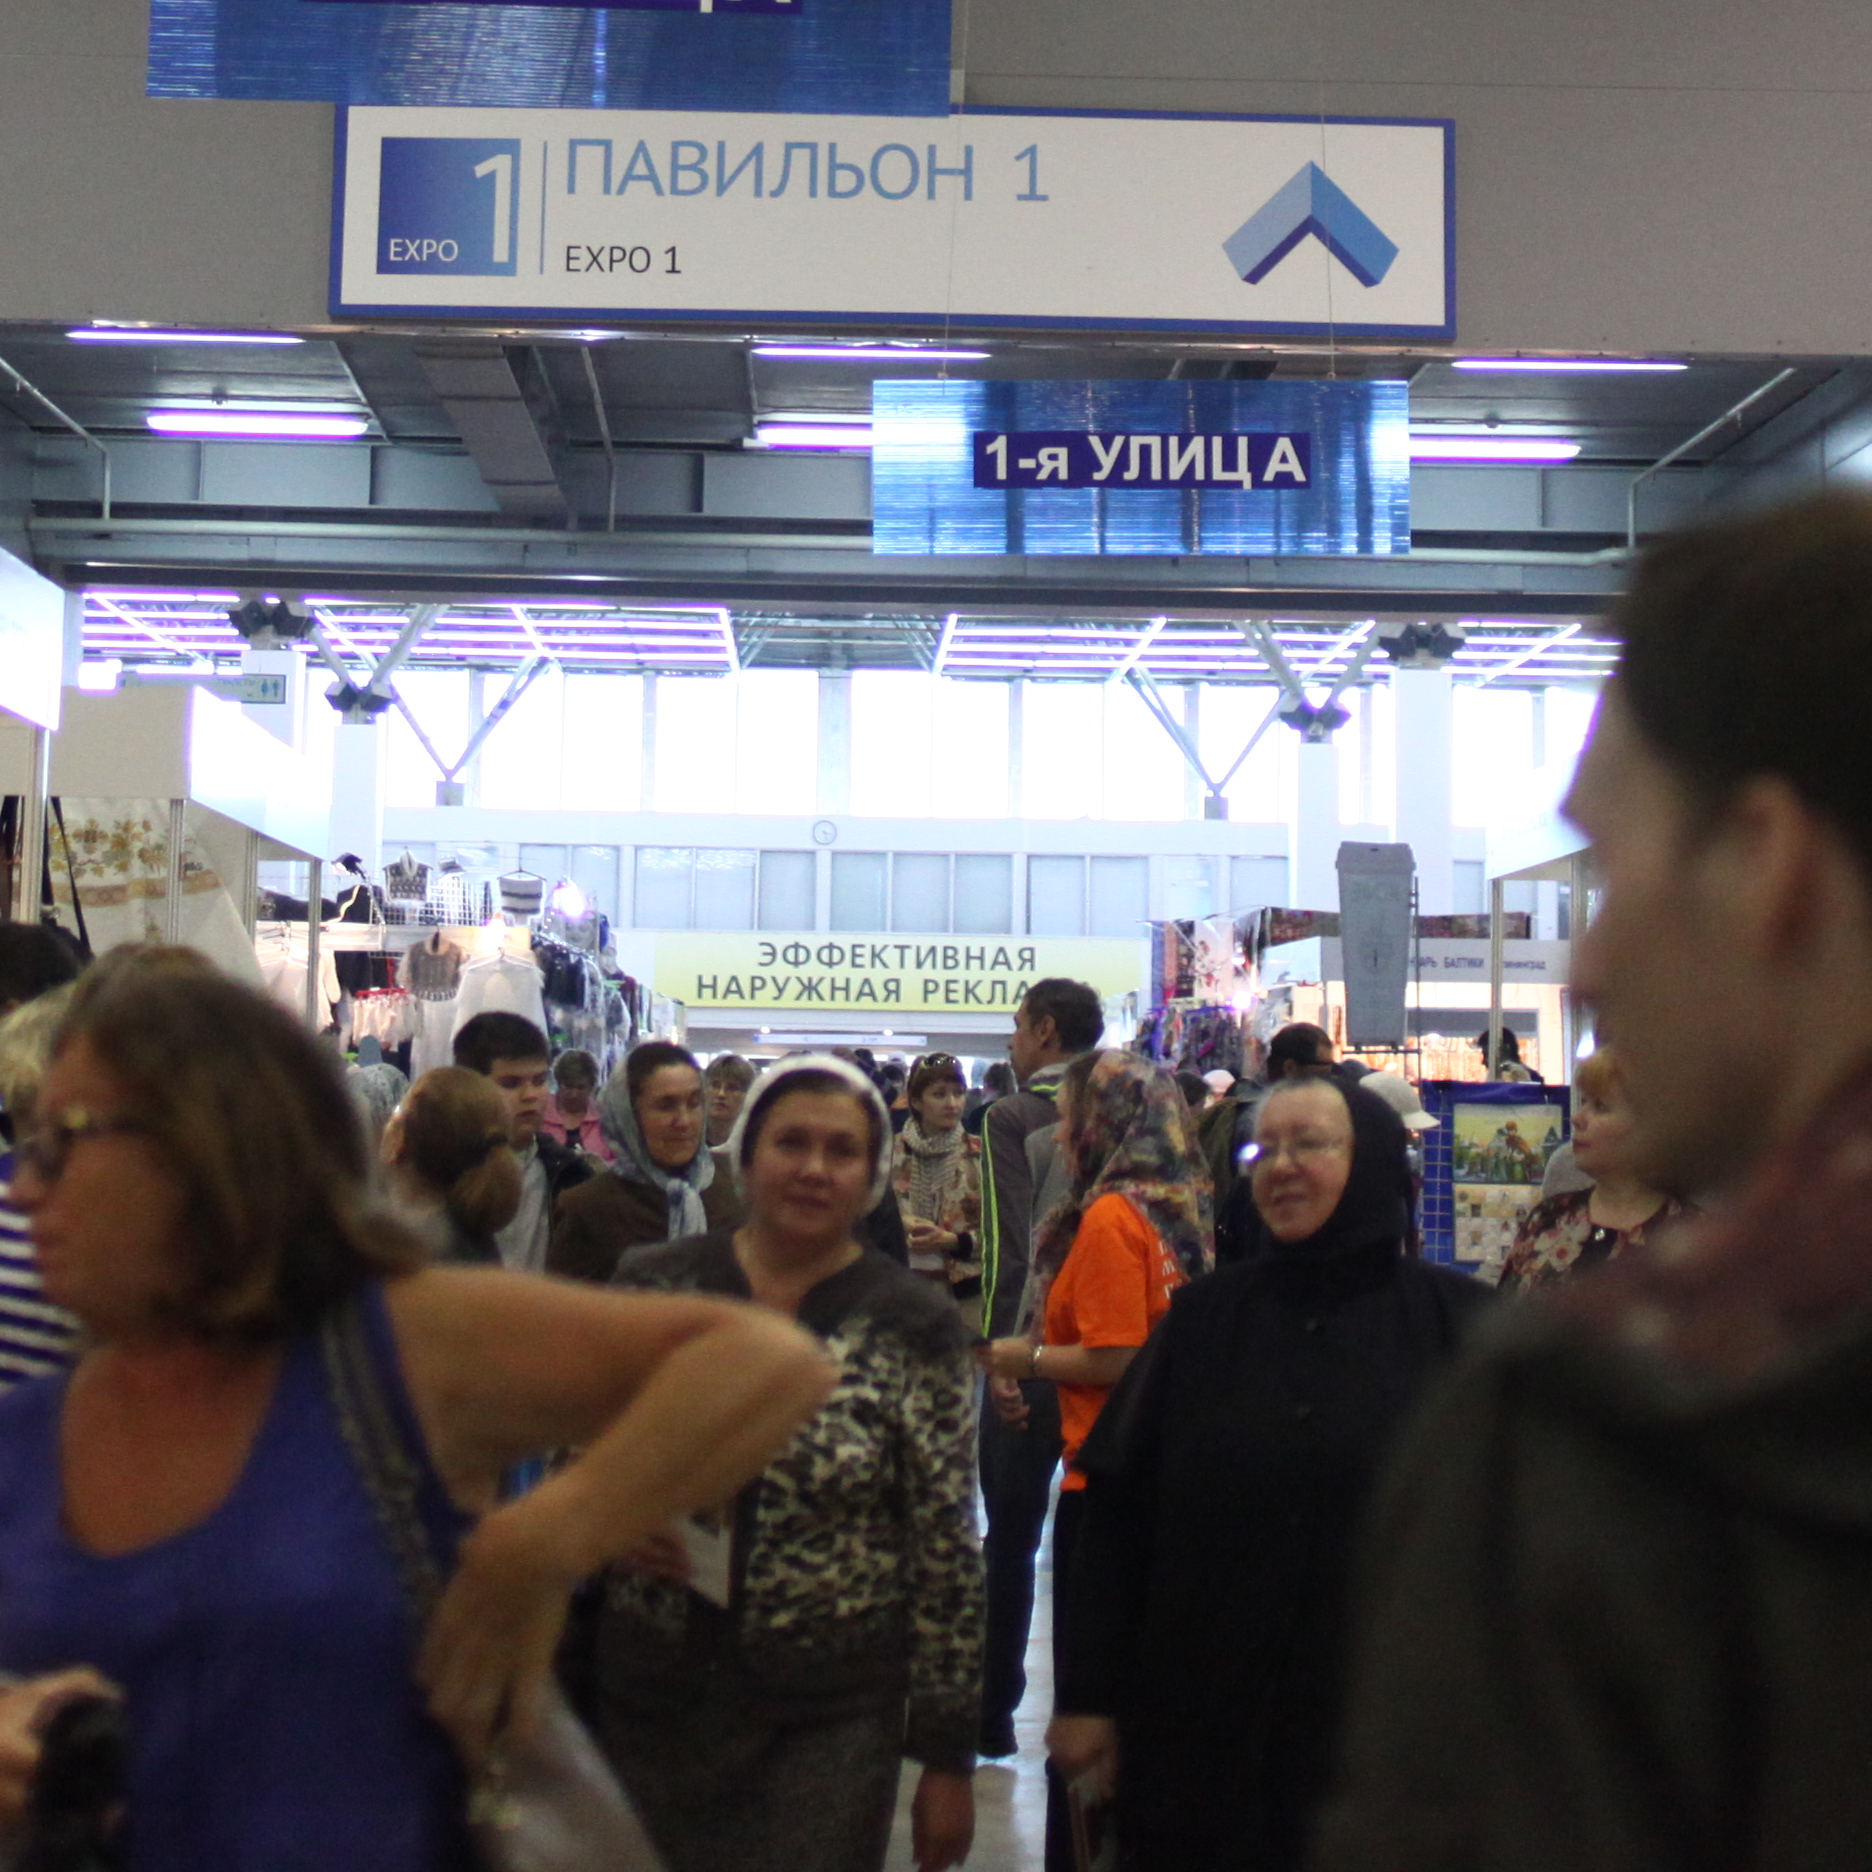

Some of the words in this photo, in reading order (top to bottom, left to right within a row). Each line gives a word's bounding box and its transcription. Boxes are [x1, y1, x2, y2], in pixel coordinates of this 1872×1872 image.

[566, 137, 974, 202] ПАВИЛЬОН
[1014, 143, 1050, 203] 1
[388, 238, 459, 263] EXPO
[474, 153, 513, 264] 1
[565, 244, 652, 274] EXPO
[664, 245, 682, 274] 1
[985, 434, 1069, 481] 1-я
[1088, 434, 1307, 490] УЛИЦА
[757, 941, 1037, 972] ЭФФЕКТИВНАЯ
[696, 974, 902, 1004] НАРУЖНАЯ
